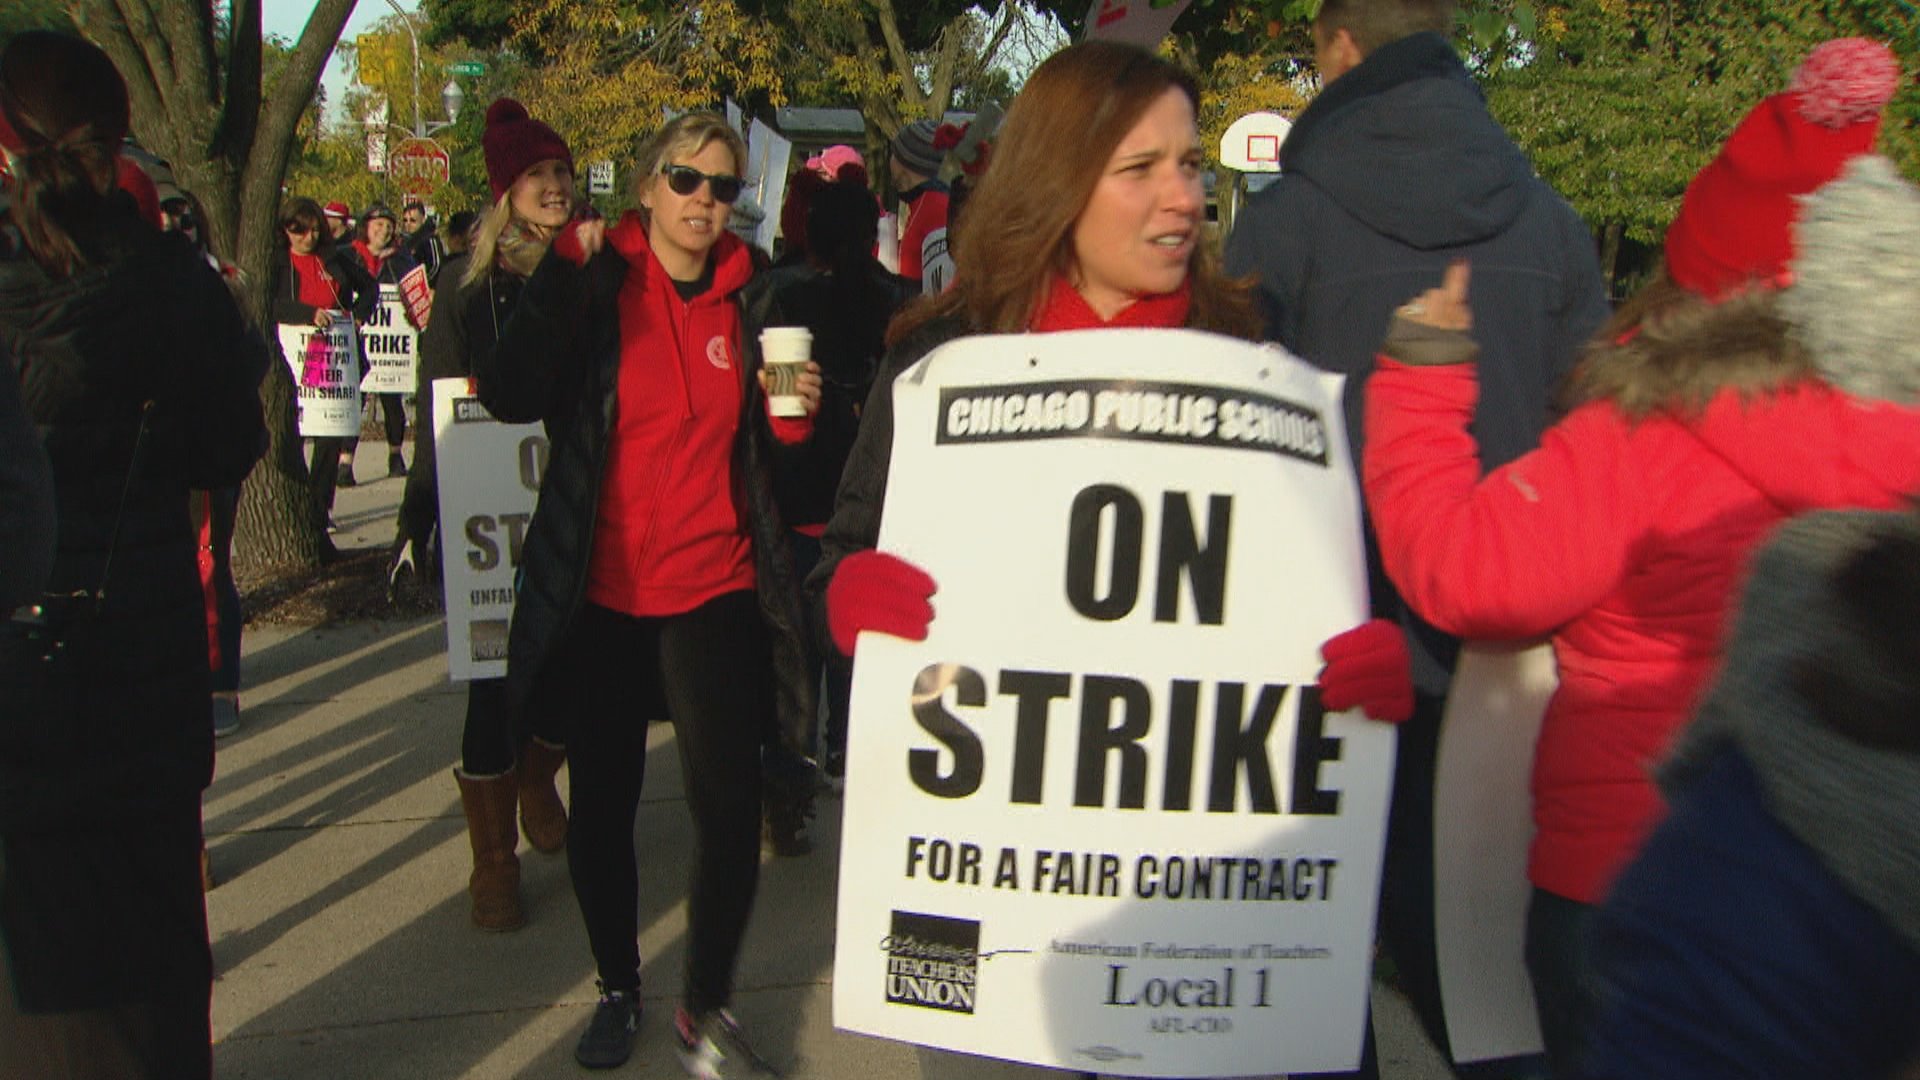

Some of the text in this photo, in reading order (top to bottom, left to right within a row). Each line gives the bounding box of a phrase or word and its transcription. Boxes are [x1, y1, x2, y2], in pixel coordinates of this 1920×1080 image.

[393, 156, 446, 178] STOP
[947, 389, 1326, 456] CHICAGO PUBLIC SCHOOLS
[465, 514, 530, 572] ST
[1065, 482, 1235, 626] ON
[470, 588, 513, 606] UNFAI
[907, 662, 1346, 816] STRIKE
[906, 836, 1339, 901] FOR A FAIR CONTRACT
[887, 957, 977, 984] TEACHERS
[1049, 940, 1138, 958] American
[1141, 942, 1233, 960] Federation
[1260, 943, 1332, 960] Teachers
[886, 974, 976, 1010] UNION
[1103, 964, 1273, 1008] Local 1
